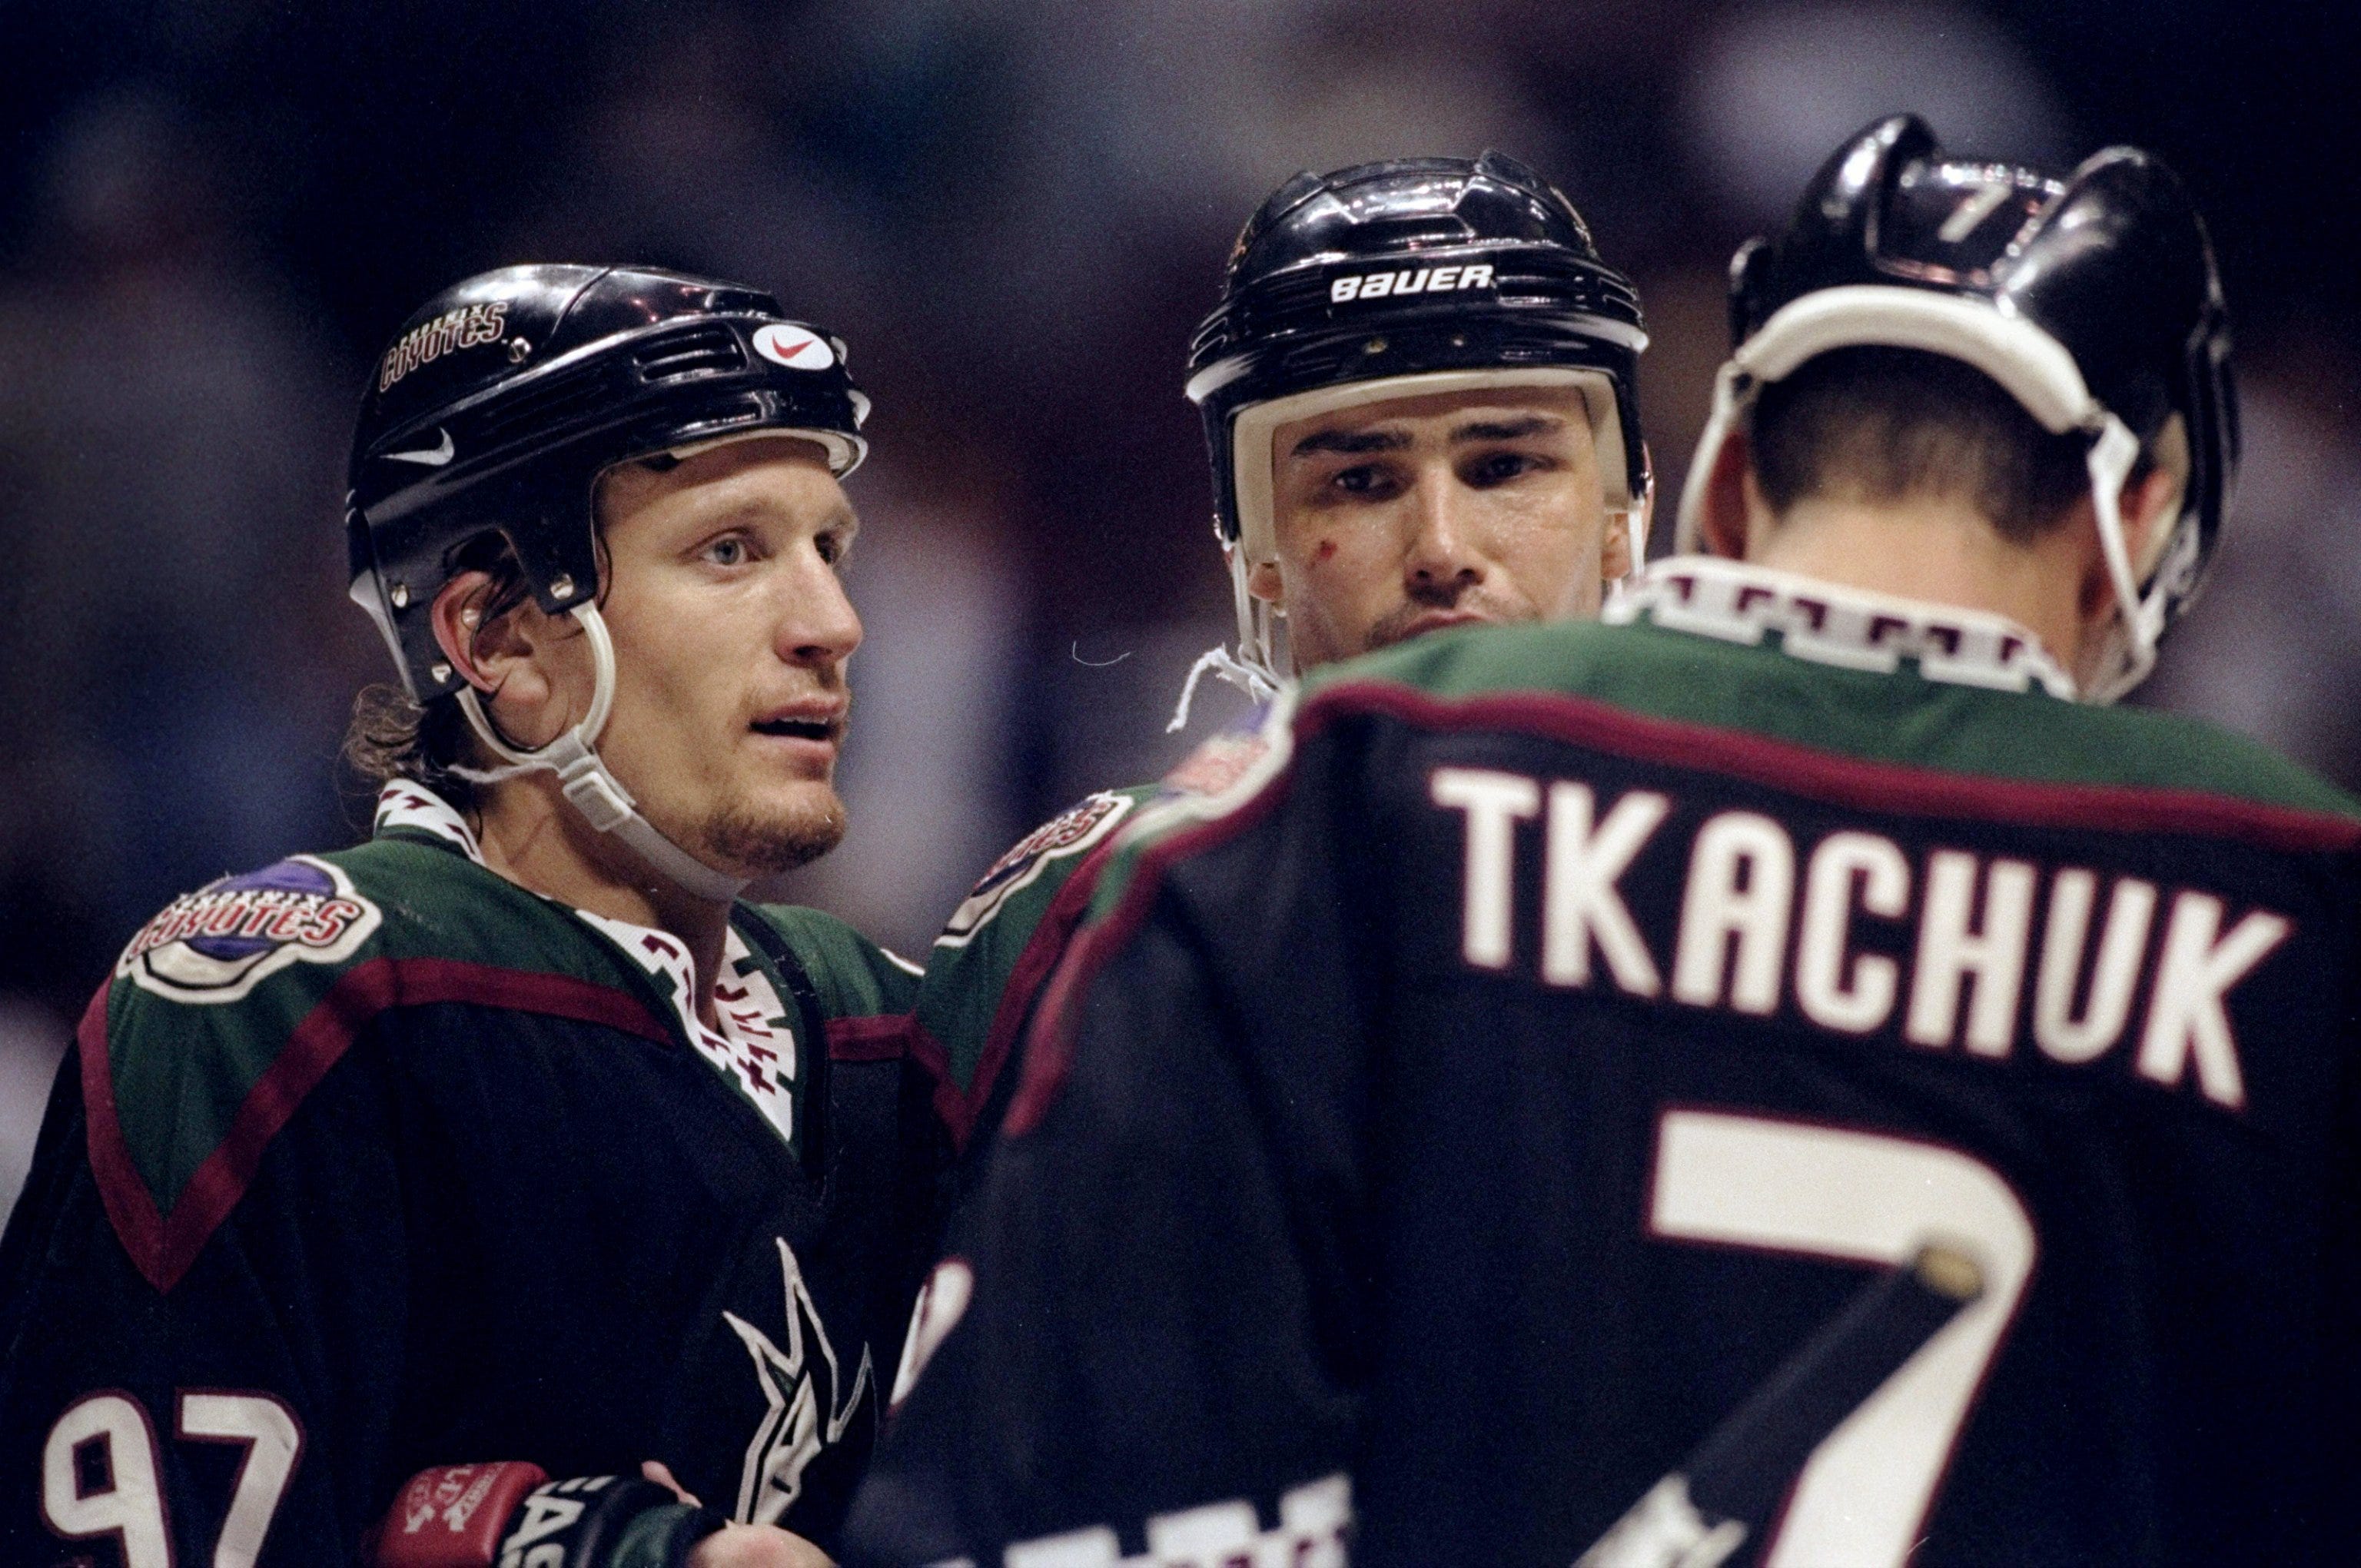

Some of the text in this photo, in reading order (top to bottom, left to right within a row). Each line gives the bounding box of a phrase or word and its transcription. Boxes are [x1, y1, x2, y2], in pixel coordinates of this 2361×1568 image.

[1929, 163, 2013, 243] 7
[1330, 264, 1494, 304] BAUER
[380, 301, 508, 393] COYOTES
[128, 899, 361, 959] COYOTES
[1430, 769, 2290, 1108] TKACHUK
[1648, 1108, 2038, 1568] 7
[42, 1390, 304, 1568] 97
